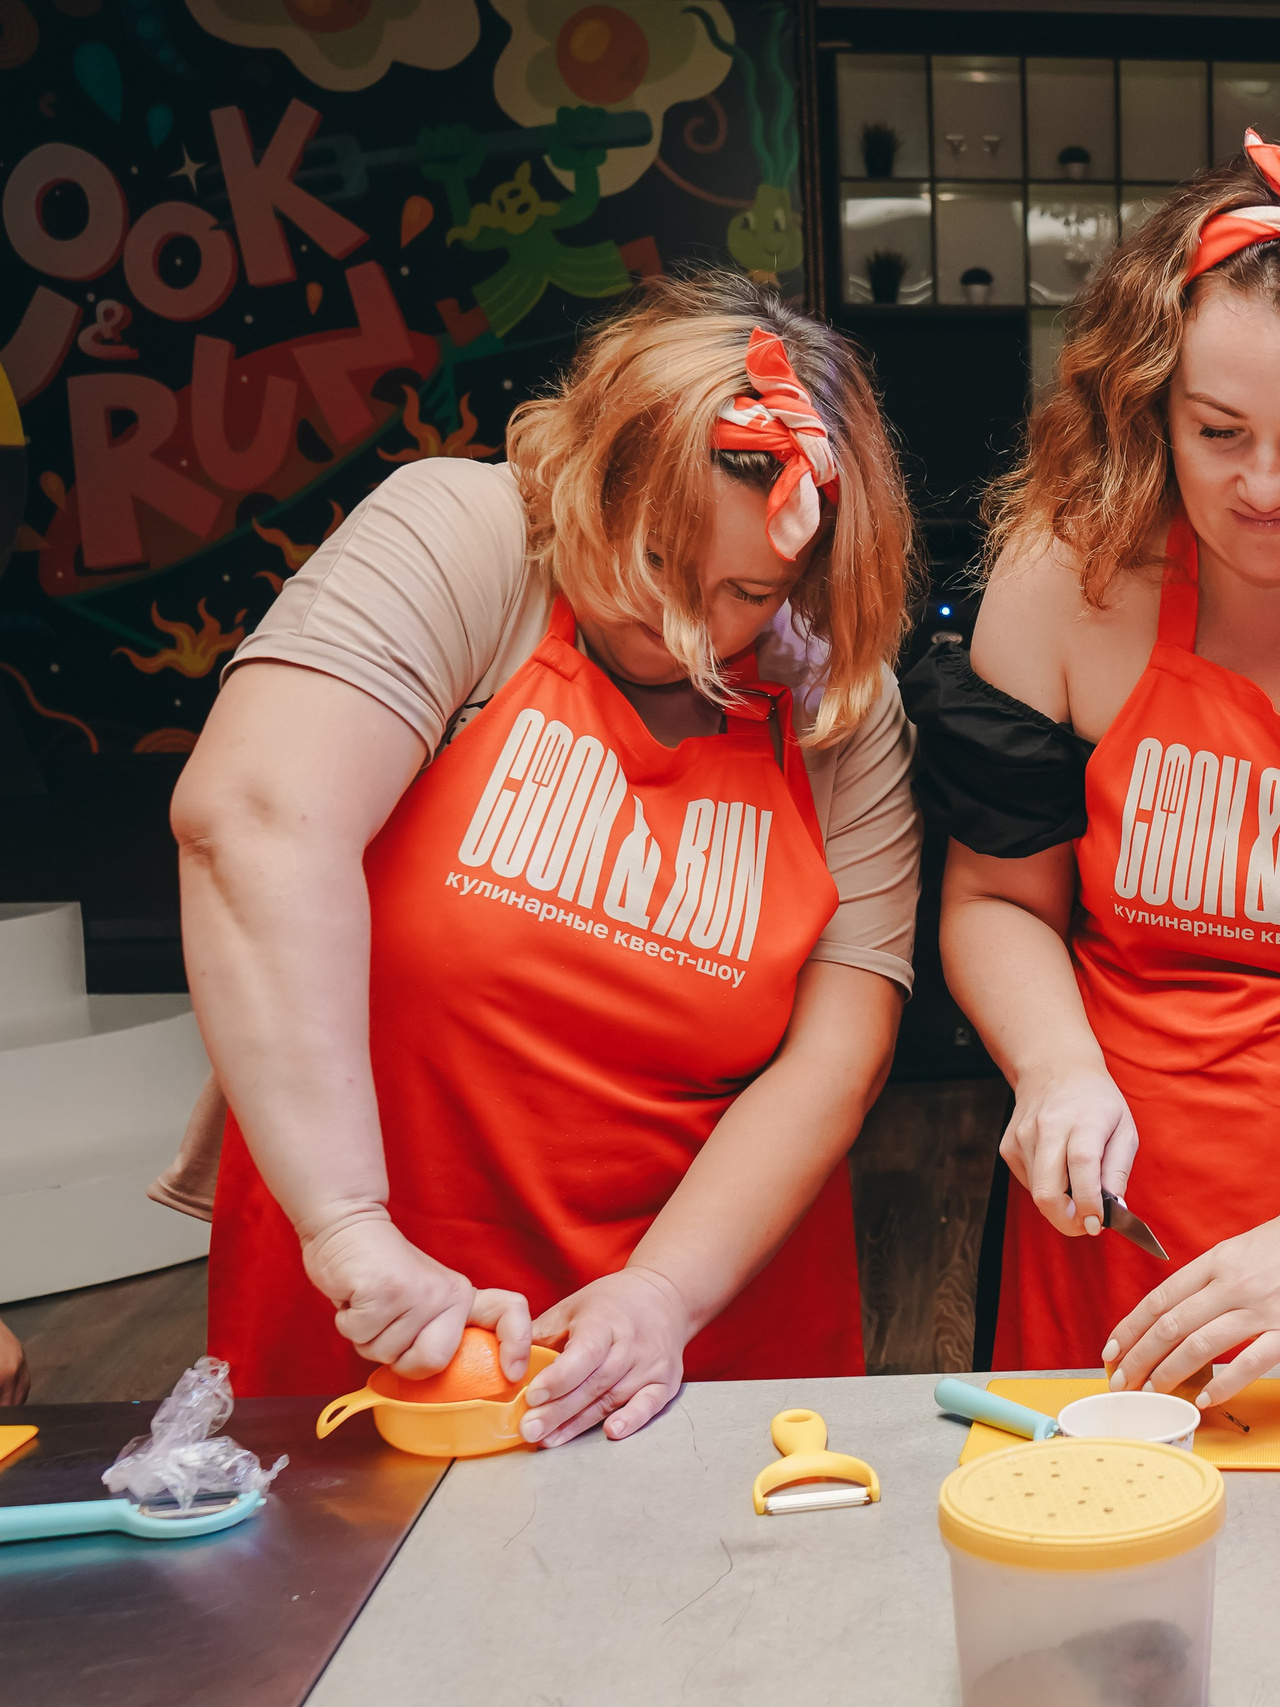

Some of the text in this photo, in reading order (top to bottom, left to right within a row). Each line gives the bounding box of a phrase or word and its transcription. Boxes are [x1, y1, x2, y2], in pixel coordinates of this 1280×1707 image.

[0, 98, 371, 405] OOK
[66, 259, 414, 570] RUN
[444, 871, 747, 988] кулинарные квест-шоу
[457, 708, 628, 910] COOK
[651, 797, 773, 962] RUN
[1114, 737, 1252, 918] COOK
[1114, 902, 1255, 941] кулинарные
